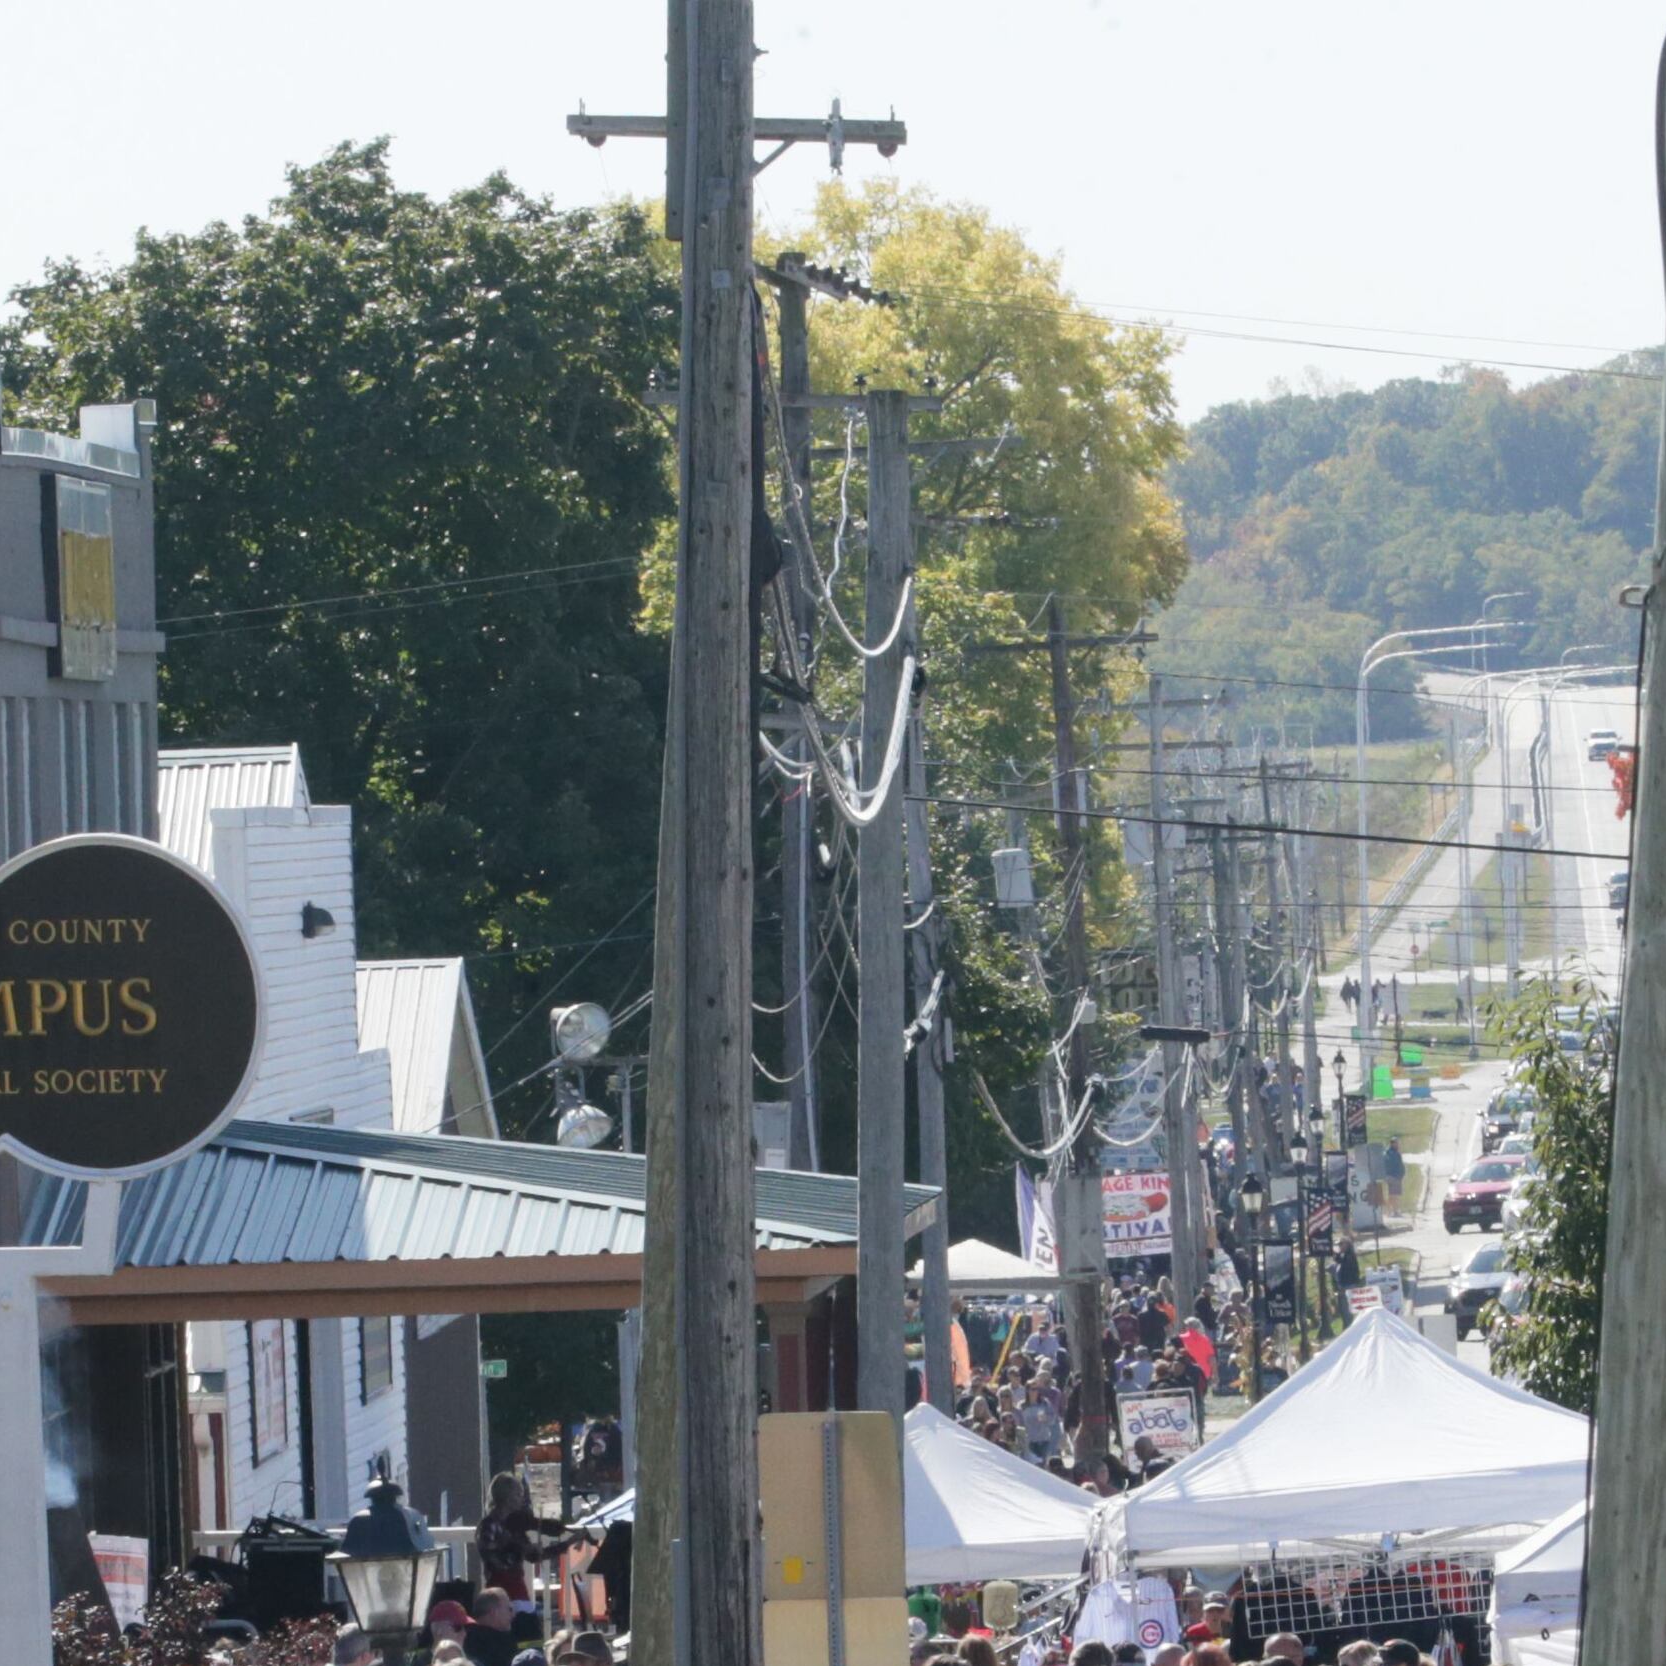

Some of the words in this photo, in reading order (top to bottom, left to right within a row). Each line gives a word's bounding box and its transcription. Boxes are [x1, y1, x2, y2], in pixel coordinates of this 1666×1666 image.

[9, 918, 152, 945] COUNTY
[34, 1068, 169, 1095] SOCIETY
[1101, 1177, 1134, 1191] AGE
